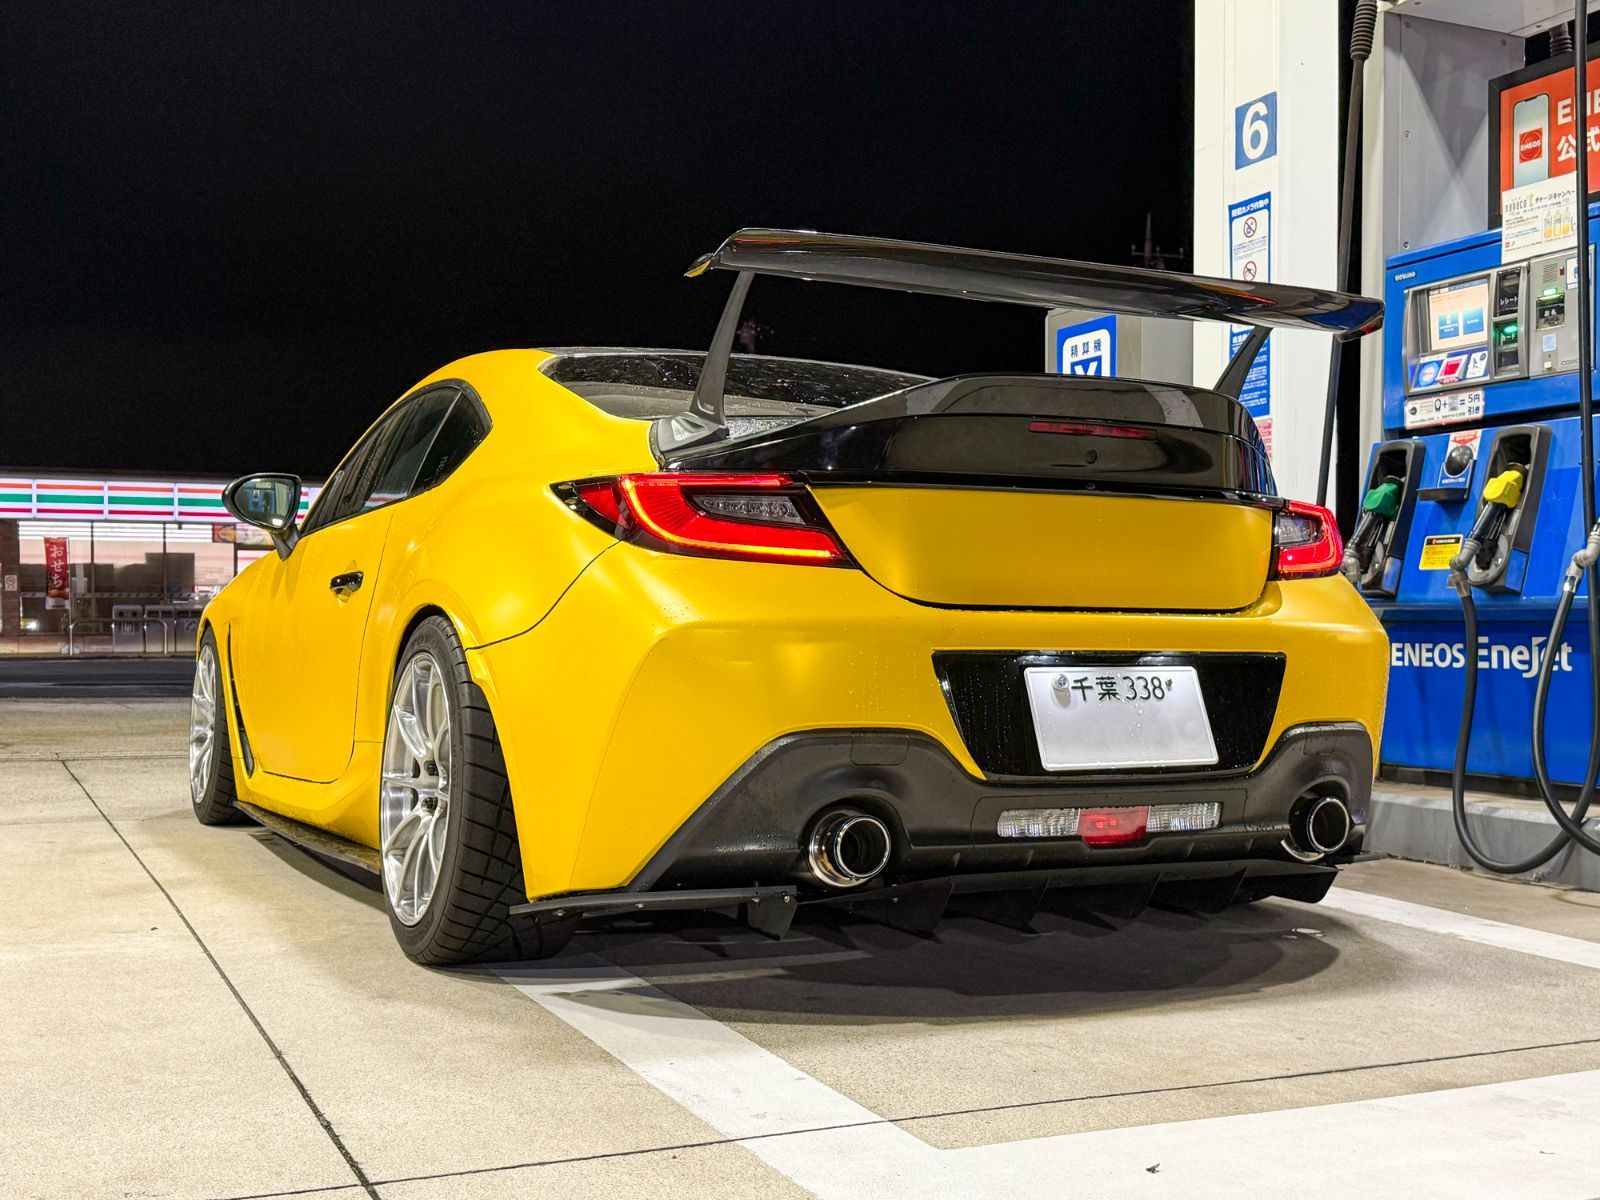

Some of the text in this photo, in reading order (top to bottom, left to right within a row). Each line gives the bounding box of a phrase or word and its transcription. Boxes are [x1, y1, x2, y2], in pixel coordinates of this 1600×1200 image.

[1242, 101, 1269, 160] 6
[1520, 139, 1542, 151] ENEOS
[1500, 296, 1518, 305] レシート
[1467, 393, 1481, 403] 5円
[49, 544, 65, 588] おせち
[1391, 642, 1466, 669] ENEOS
[1071, 676, 1165, 702] 千葉 338
